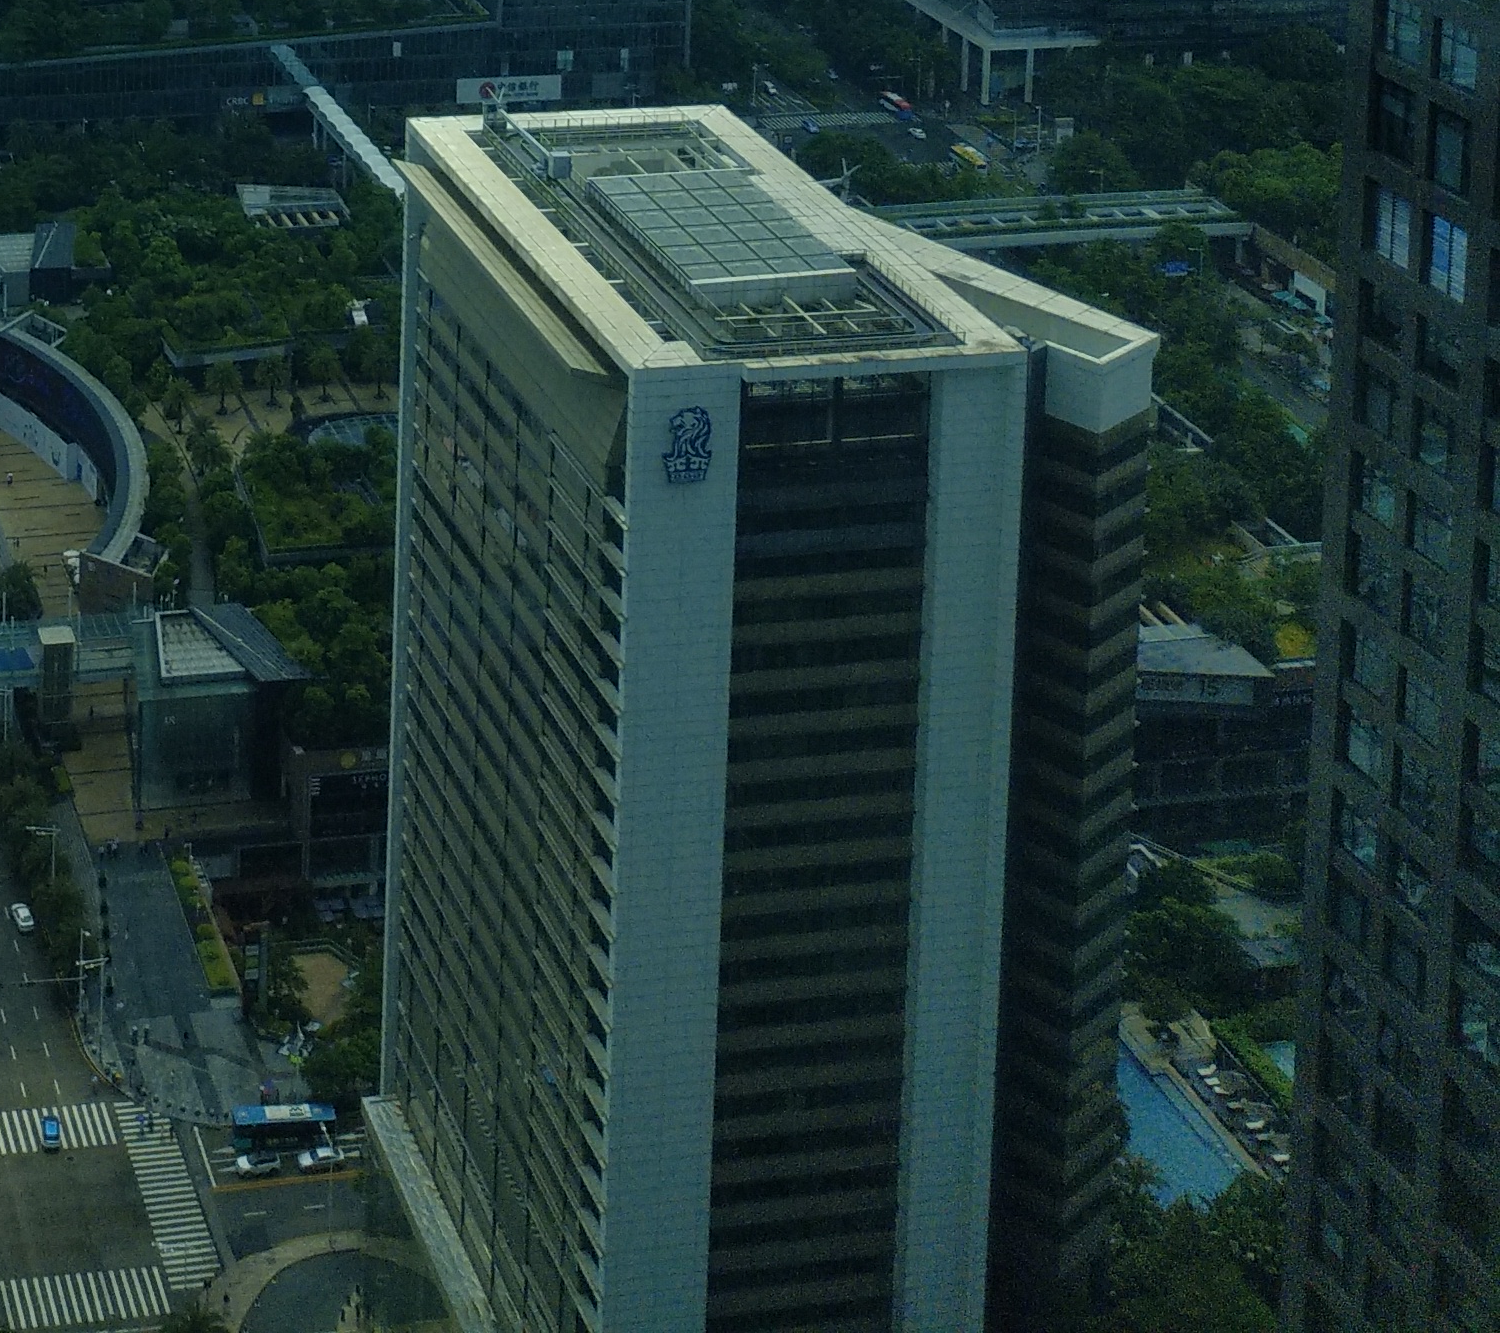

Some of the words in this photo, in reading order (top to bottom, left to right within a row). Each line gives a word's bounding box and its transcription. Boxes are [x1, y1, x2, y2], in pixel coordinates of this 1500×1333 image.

[498, 81, 539, 92] 中信银行
[352, 773, 387, 785] SEPHO
